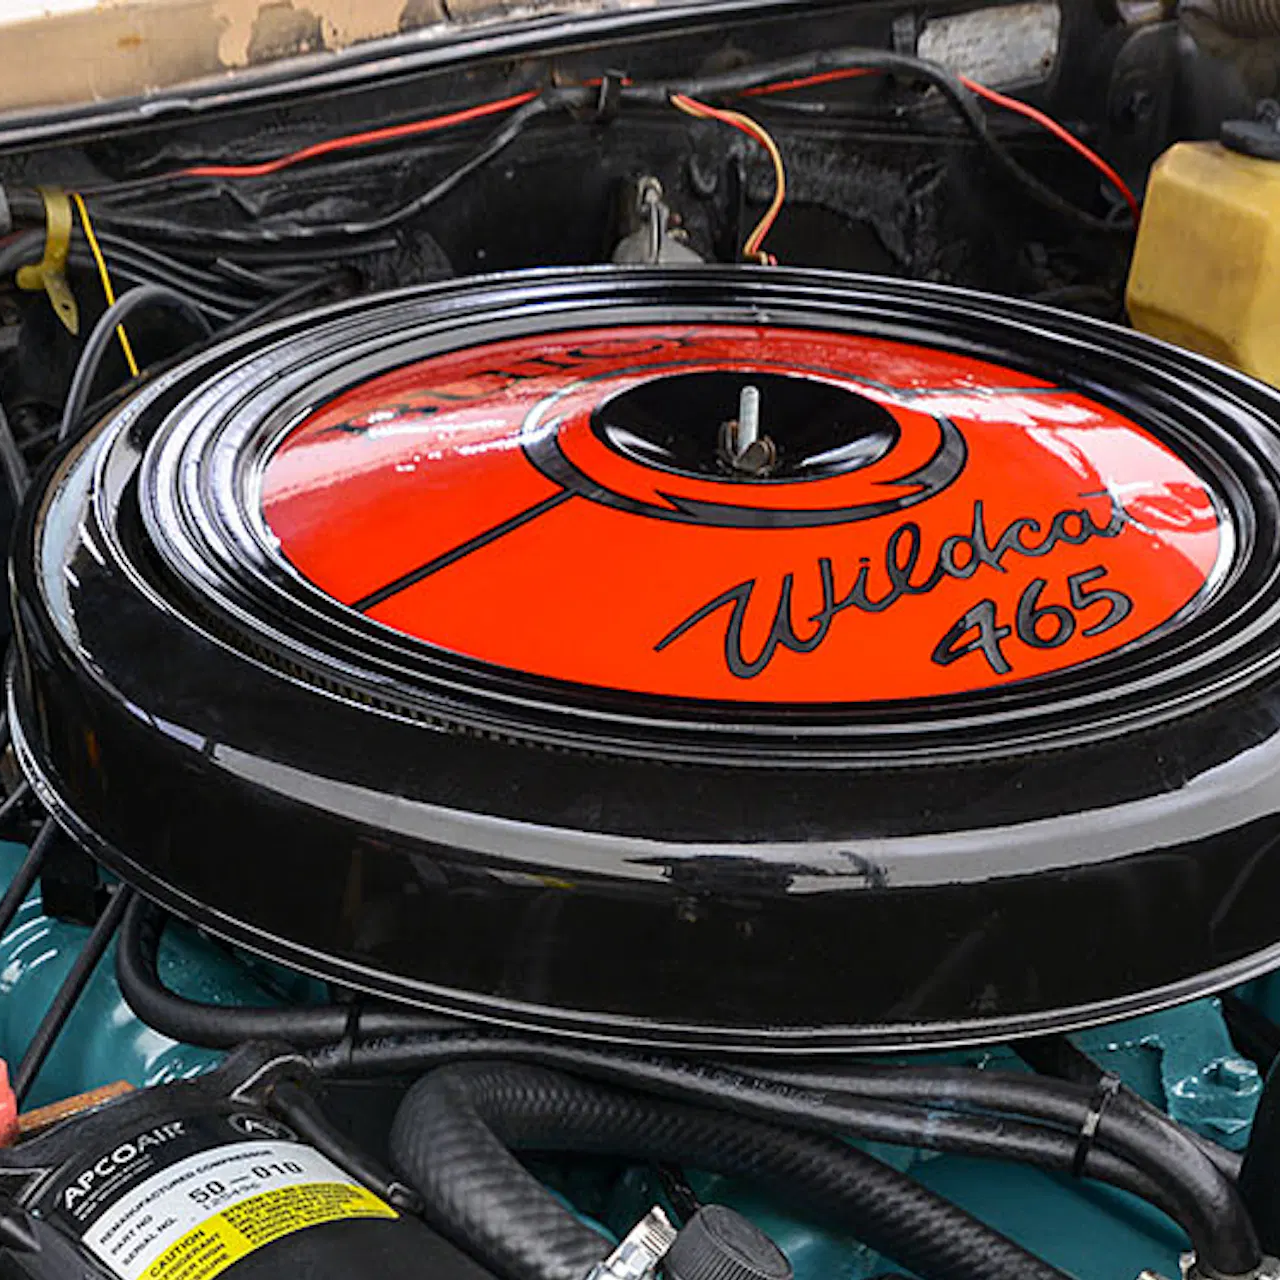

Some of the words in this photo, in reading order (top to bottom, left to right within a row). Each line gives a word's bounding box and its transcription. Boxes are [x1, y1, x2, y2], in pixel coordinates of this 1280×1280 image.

[653, 490, 1150, 679] Wildcat
[931, 565, 1133, 676] 465
[65, 1121, 186, 1210] APCOAIR
[150, 1229, 205, 1278] CAUTION
